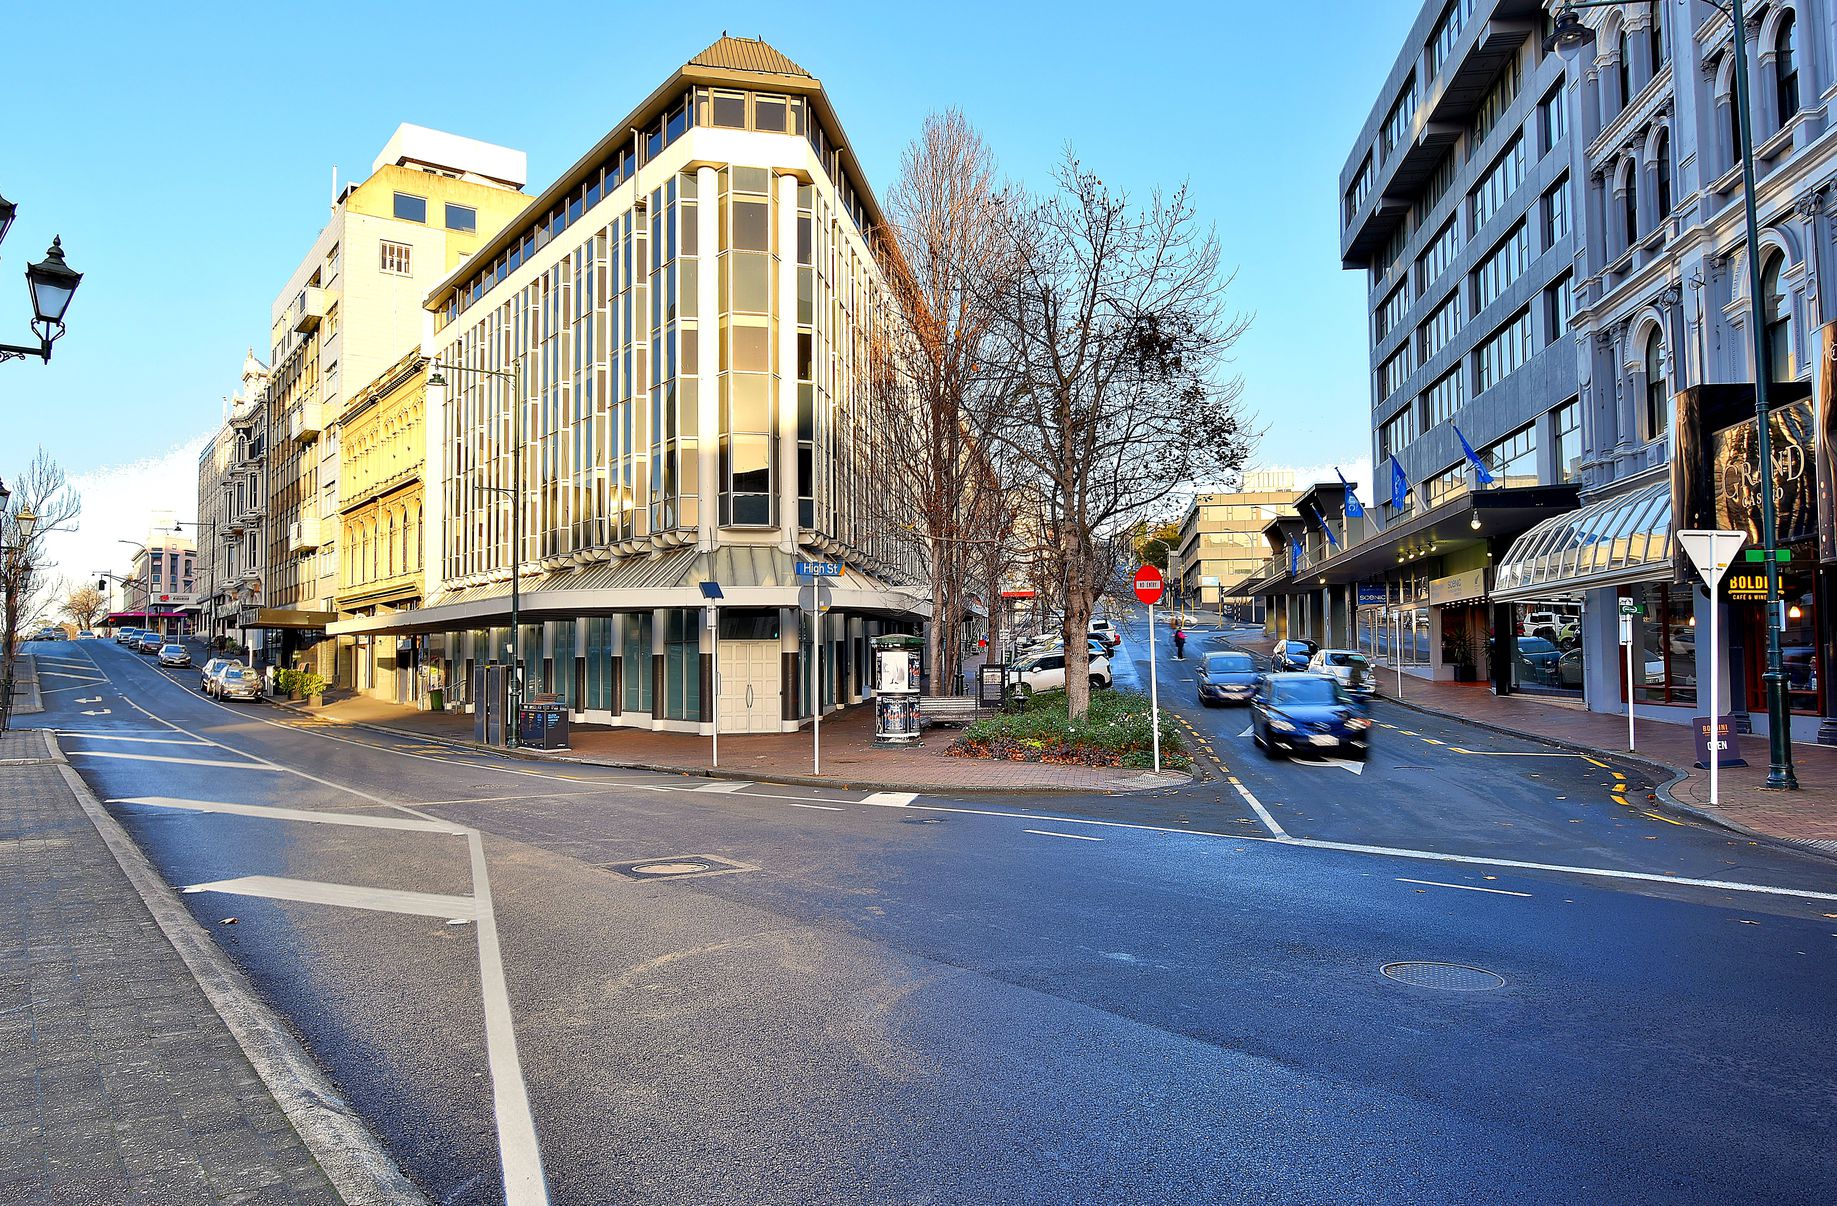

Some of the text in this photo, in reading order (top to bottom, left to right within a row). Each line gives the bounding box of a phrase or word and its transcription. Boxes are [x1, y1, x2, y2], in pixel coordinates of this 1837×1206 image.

[1721, 444, 1805, 503] GRND
[1741, 487, 1784, 507] CASO
[803, 562, 838, 575] High St
[1729, 575, 1783, 589] BOLDII
[1706, 740, 1728, 750] OEN
